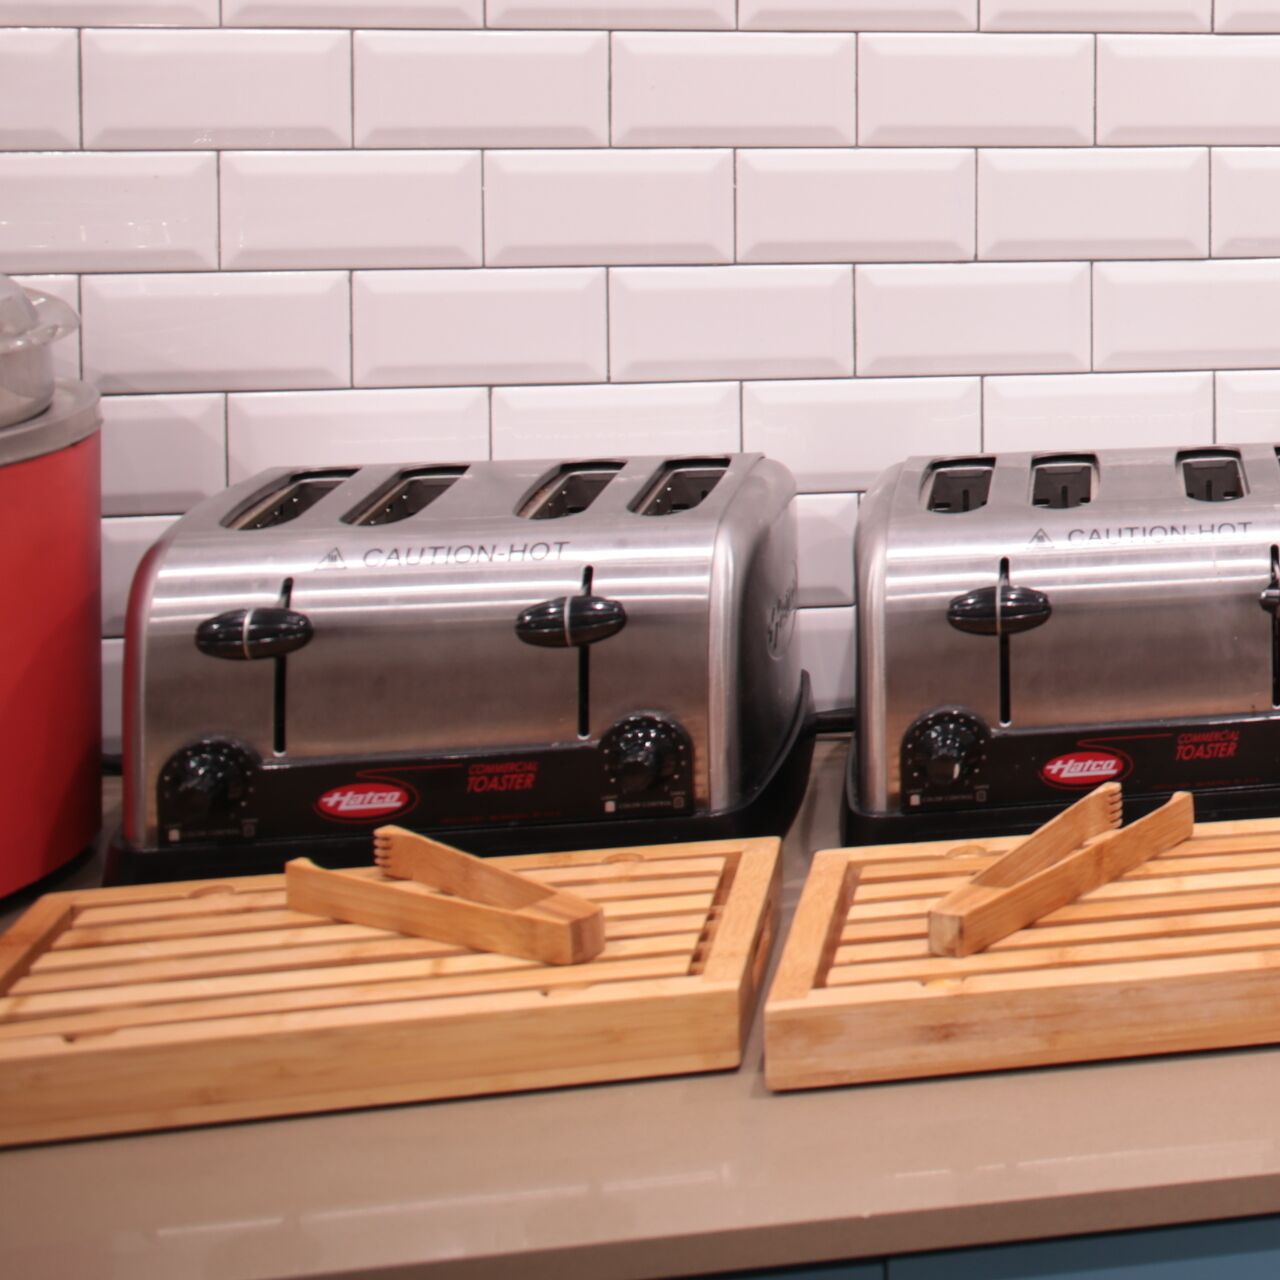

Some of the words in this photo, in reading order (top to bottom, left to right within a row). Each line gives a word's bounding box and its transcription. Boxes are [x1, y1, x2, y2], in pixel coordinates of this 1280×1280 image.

[362, 541, 571, 568] CAUTION-HOT
[1177, 730, 1240, 744] COMMERCIAL
[1175, 742, 1239, 761] TOASTER
[468, 761, 539, 775] COMMERCIAL
[1046, 759, 1118, 778] Hatco
[466, 773, 536, 794] TOASTER
[321, 791, 403, 811] Hatco
